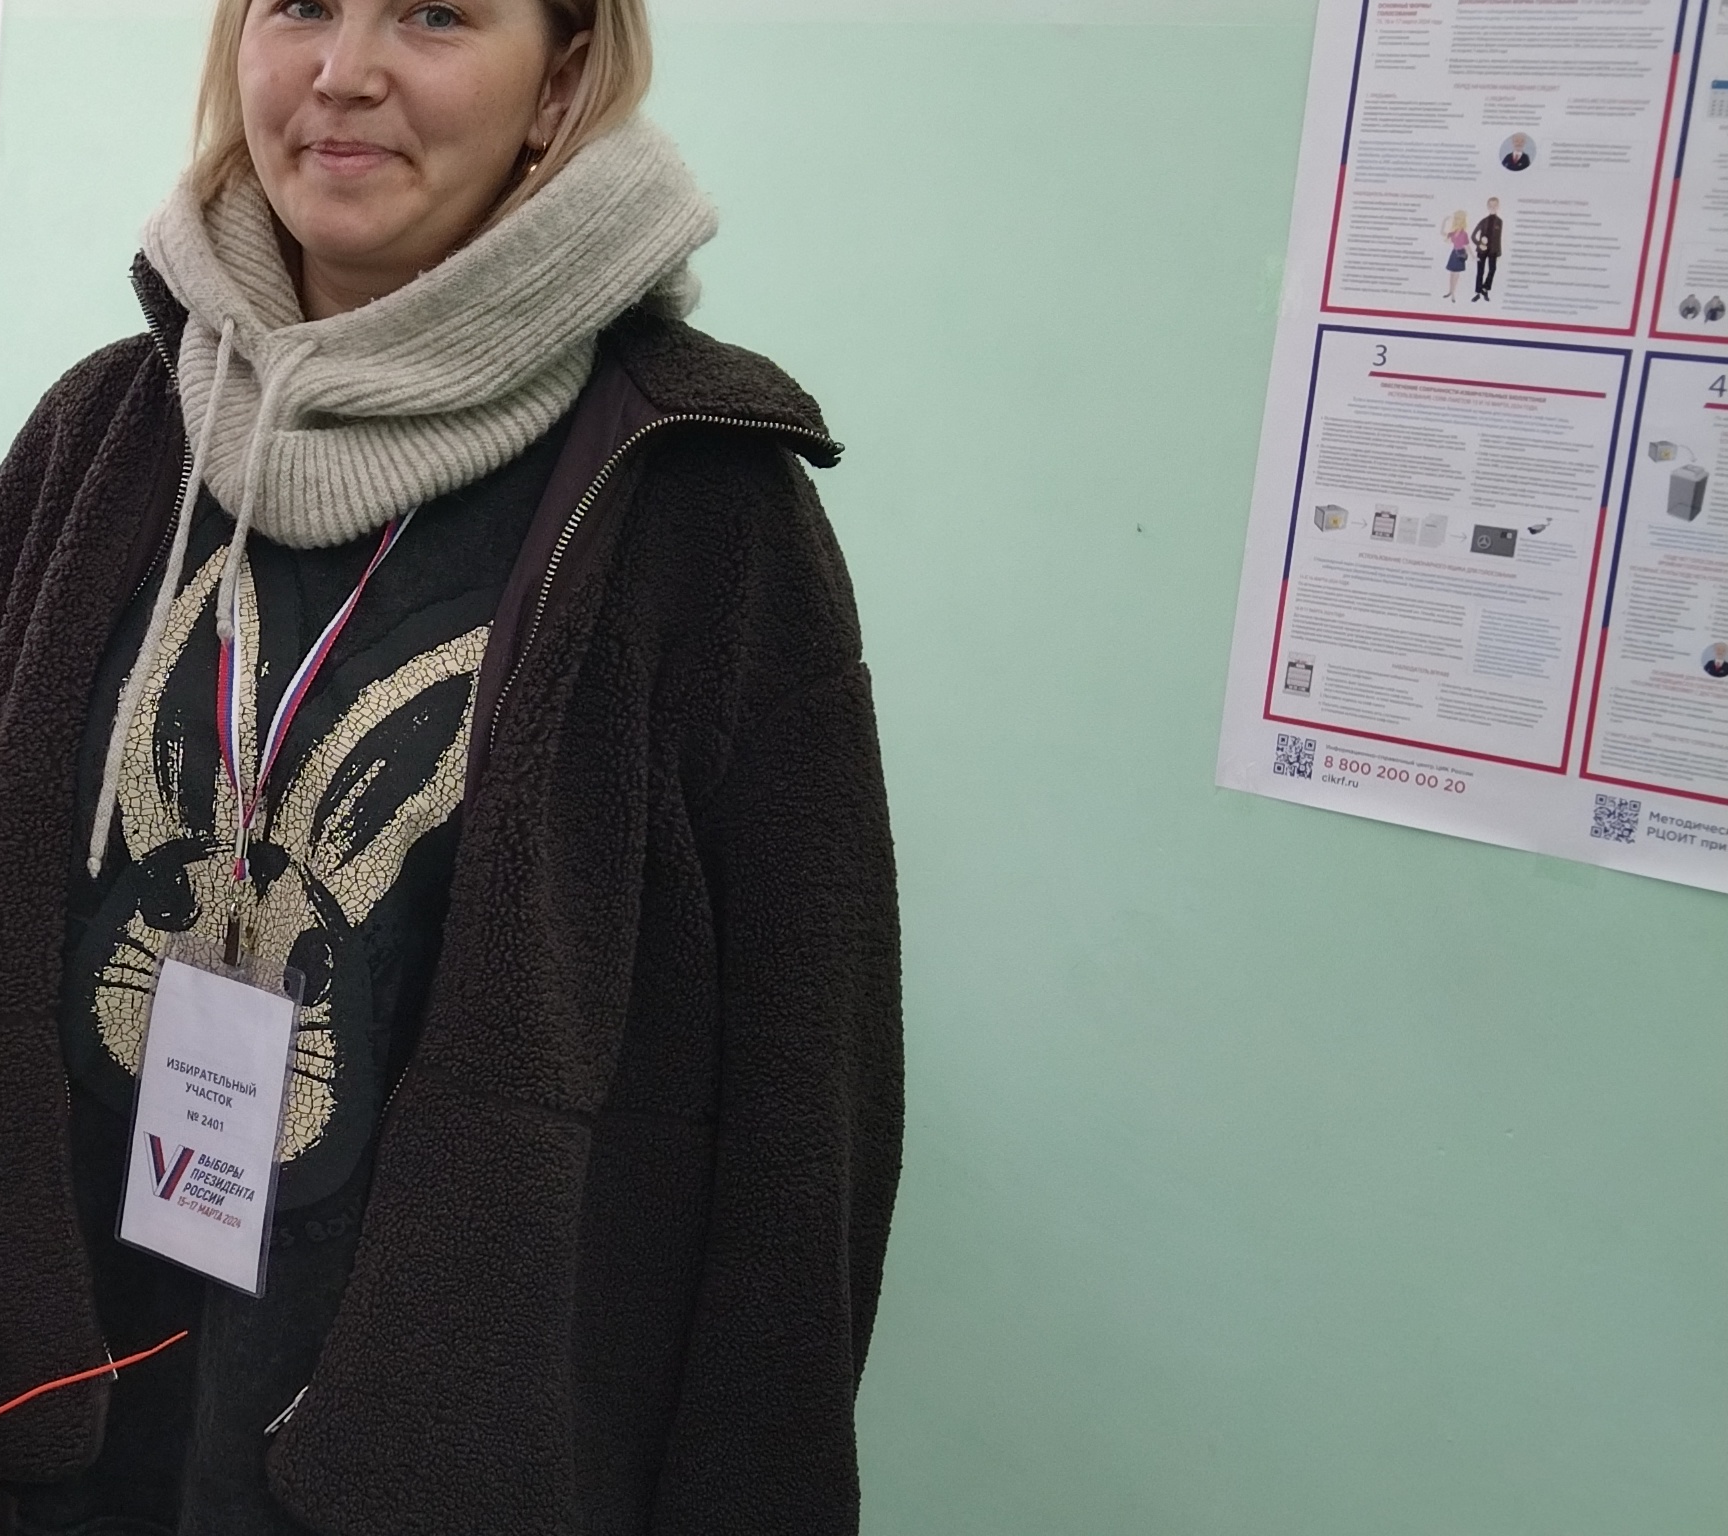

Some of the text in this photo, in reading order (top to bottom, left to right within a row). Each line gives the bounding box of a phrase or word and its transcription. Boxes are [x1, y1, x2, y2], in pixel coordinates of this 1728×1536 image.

[1372, 344, 1388, 367] 3
[1708, 374, 1728, 399] 4
[1322, 773, 1359, 789] cikrf.ru
[1324, 755, 1466, 794] 8 800 200 00 20
[1647, 826, 1697, 845] РЦОИТ
[166, 1057, 257, 1098] ИЗБИРАТЕЛЬНЫЙ
[185, 1082, 233, 1109] УЧАСТОК
[187, 1109, 224, 1132] № 2401
[198, 1154, 245, 1180] ВЫБОРЫ
[182, 1182, 226, 1206] РОССИИ
[190, 1168, 256, 1202] ПРЕЗИДЕНТА
[197, 1203, 223, 1221] МАРТА
[222, 1213, 242, 1229] 2024
